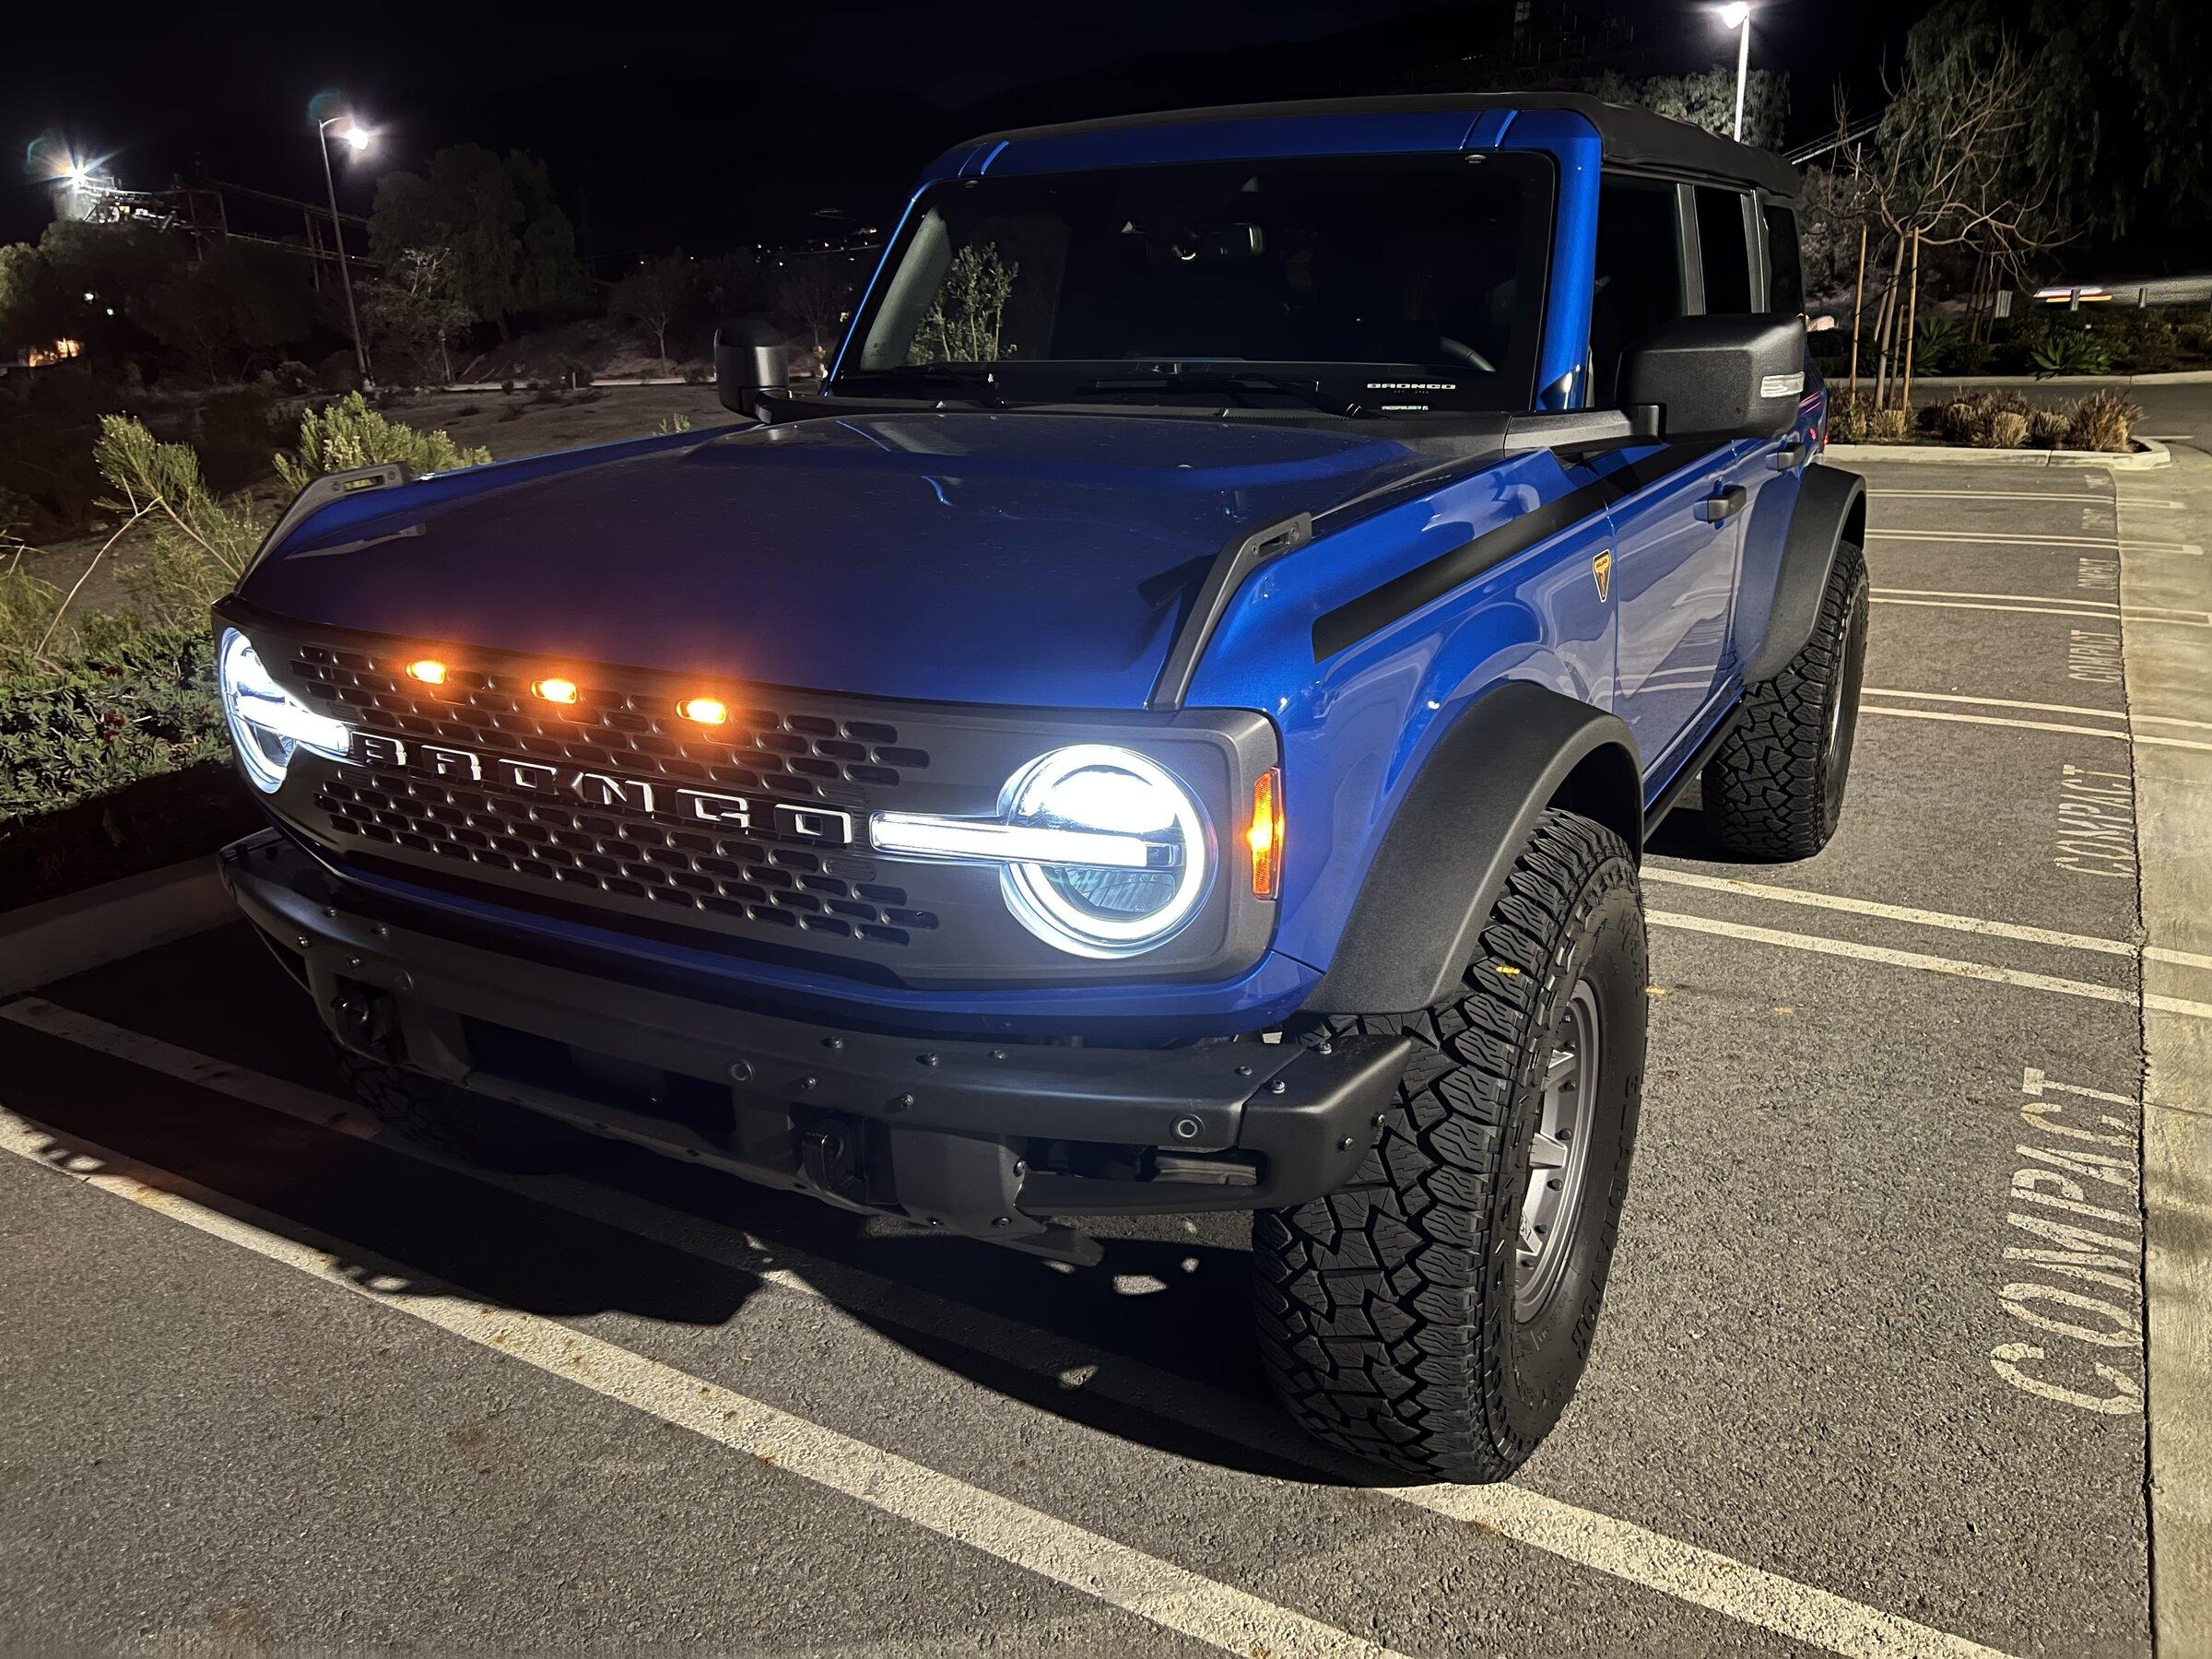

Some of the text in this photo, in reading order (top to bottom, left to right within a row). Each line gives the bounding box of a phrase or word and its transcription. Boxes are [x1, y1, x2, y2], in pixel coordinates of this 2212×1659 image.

[2068, 629, 2122, 683] COMPACT
[351, 732, 852, 844] BRONCO
[2054, 764, 2136, 878] COMPACT
[1990, 1066, 2144, 1415] COMPACT
